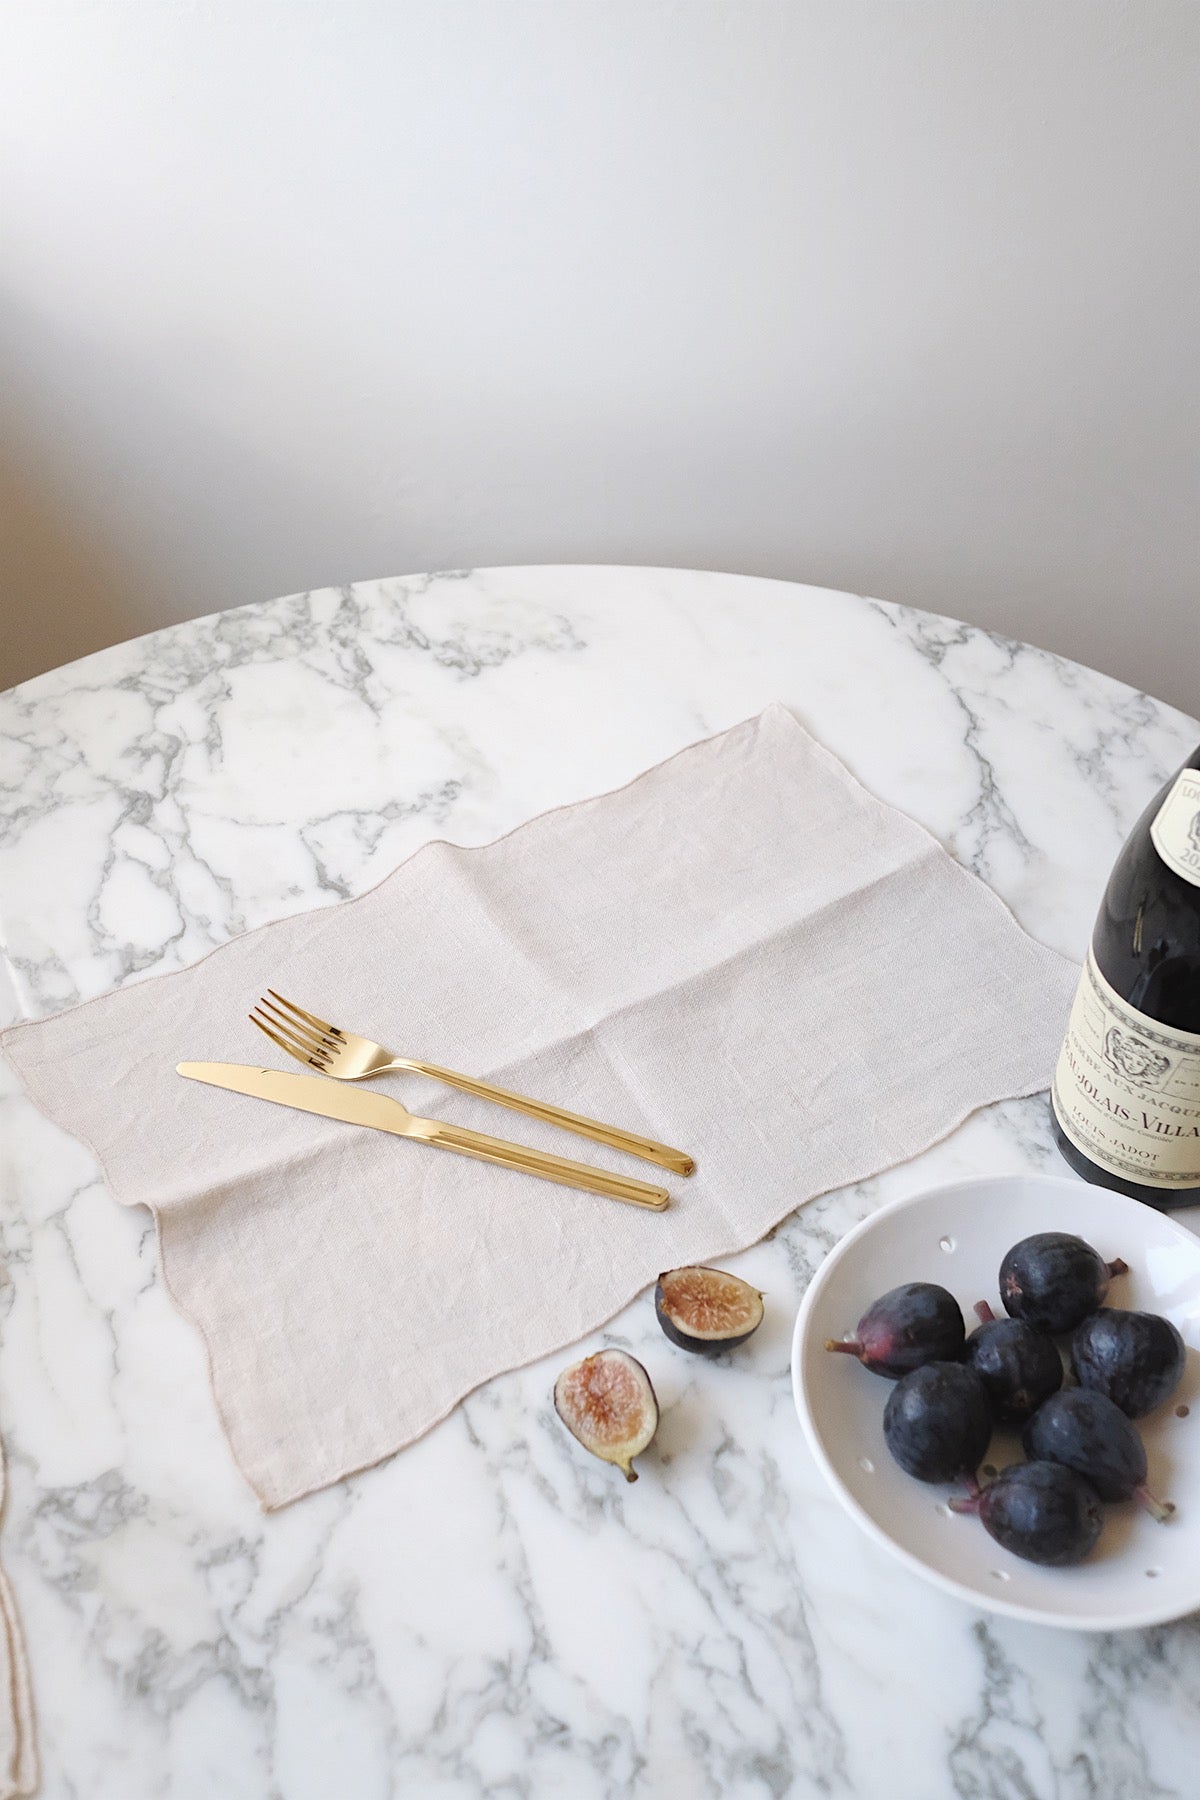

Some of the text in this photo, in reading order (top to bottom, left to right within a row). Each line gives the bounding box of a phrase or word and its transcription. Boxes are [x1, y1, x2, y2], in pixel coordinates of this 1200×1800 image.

[1179, 847, 1200, 870] 20
[1103, 1073, 1134, 1095] AUX
[1073, 1105, 1160, 1161] LOUIS JADOT
